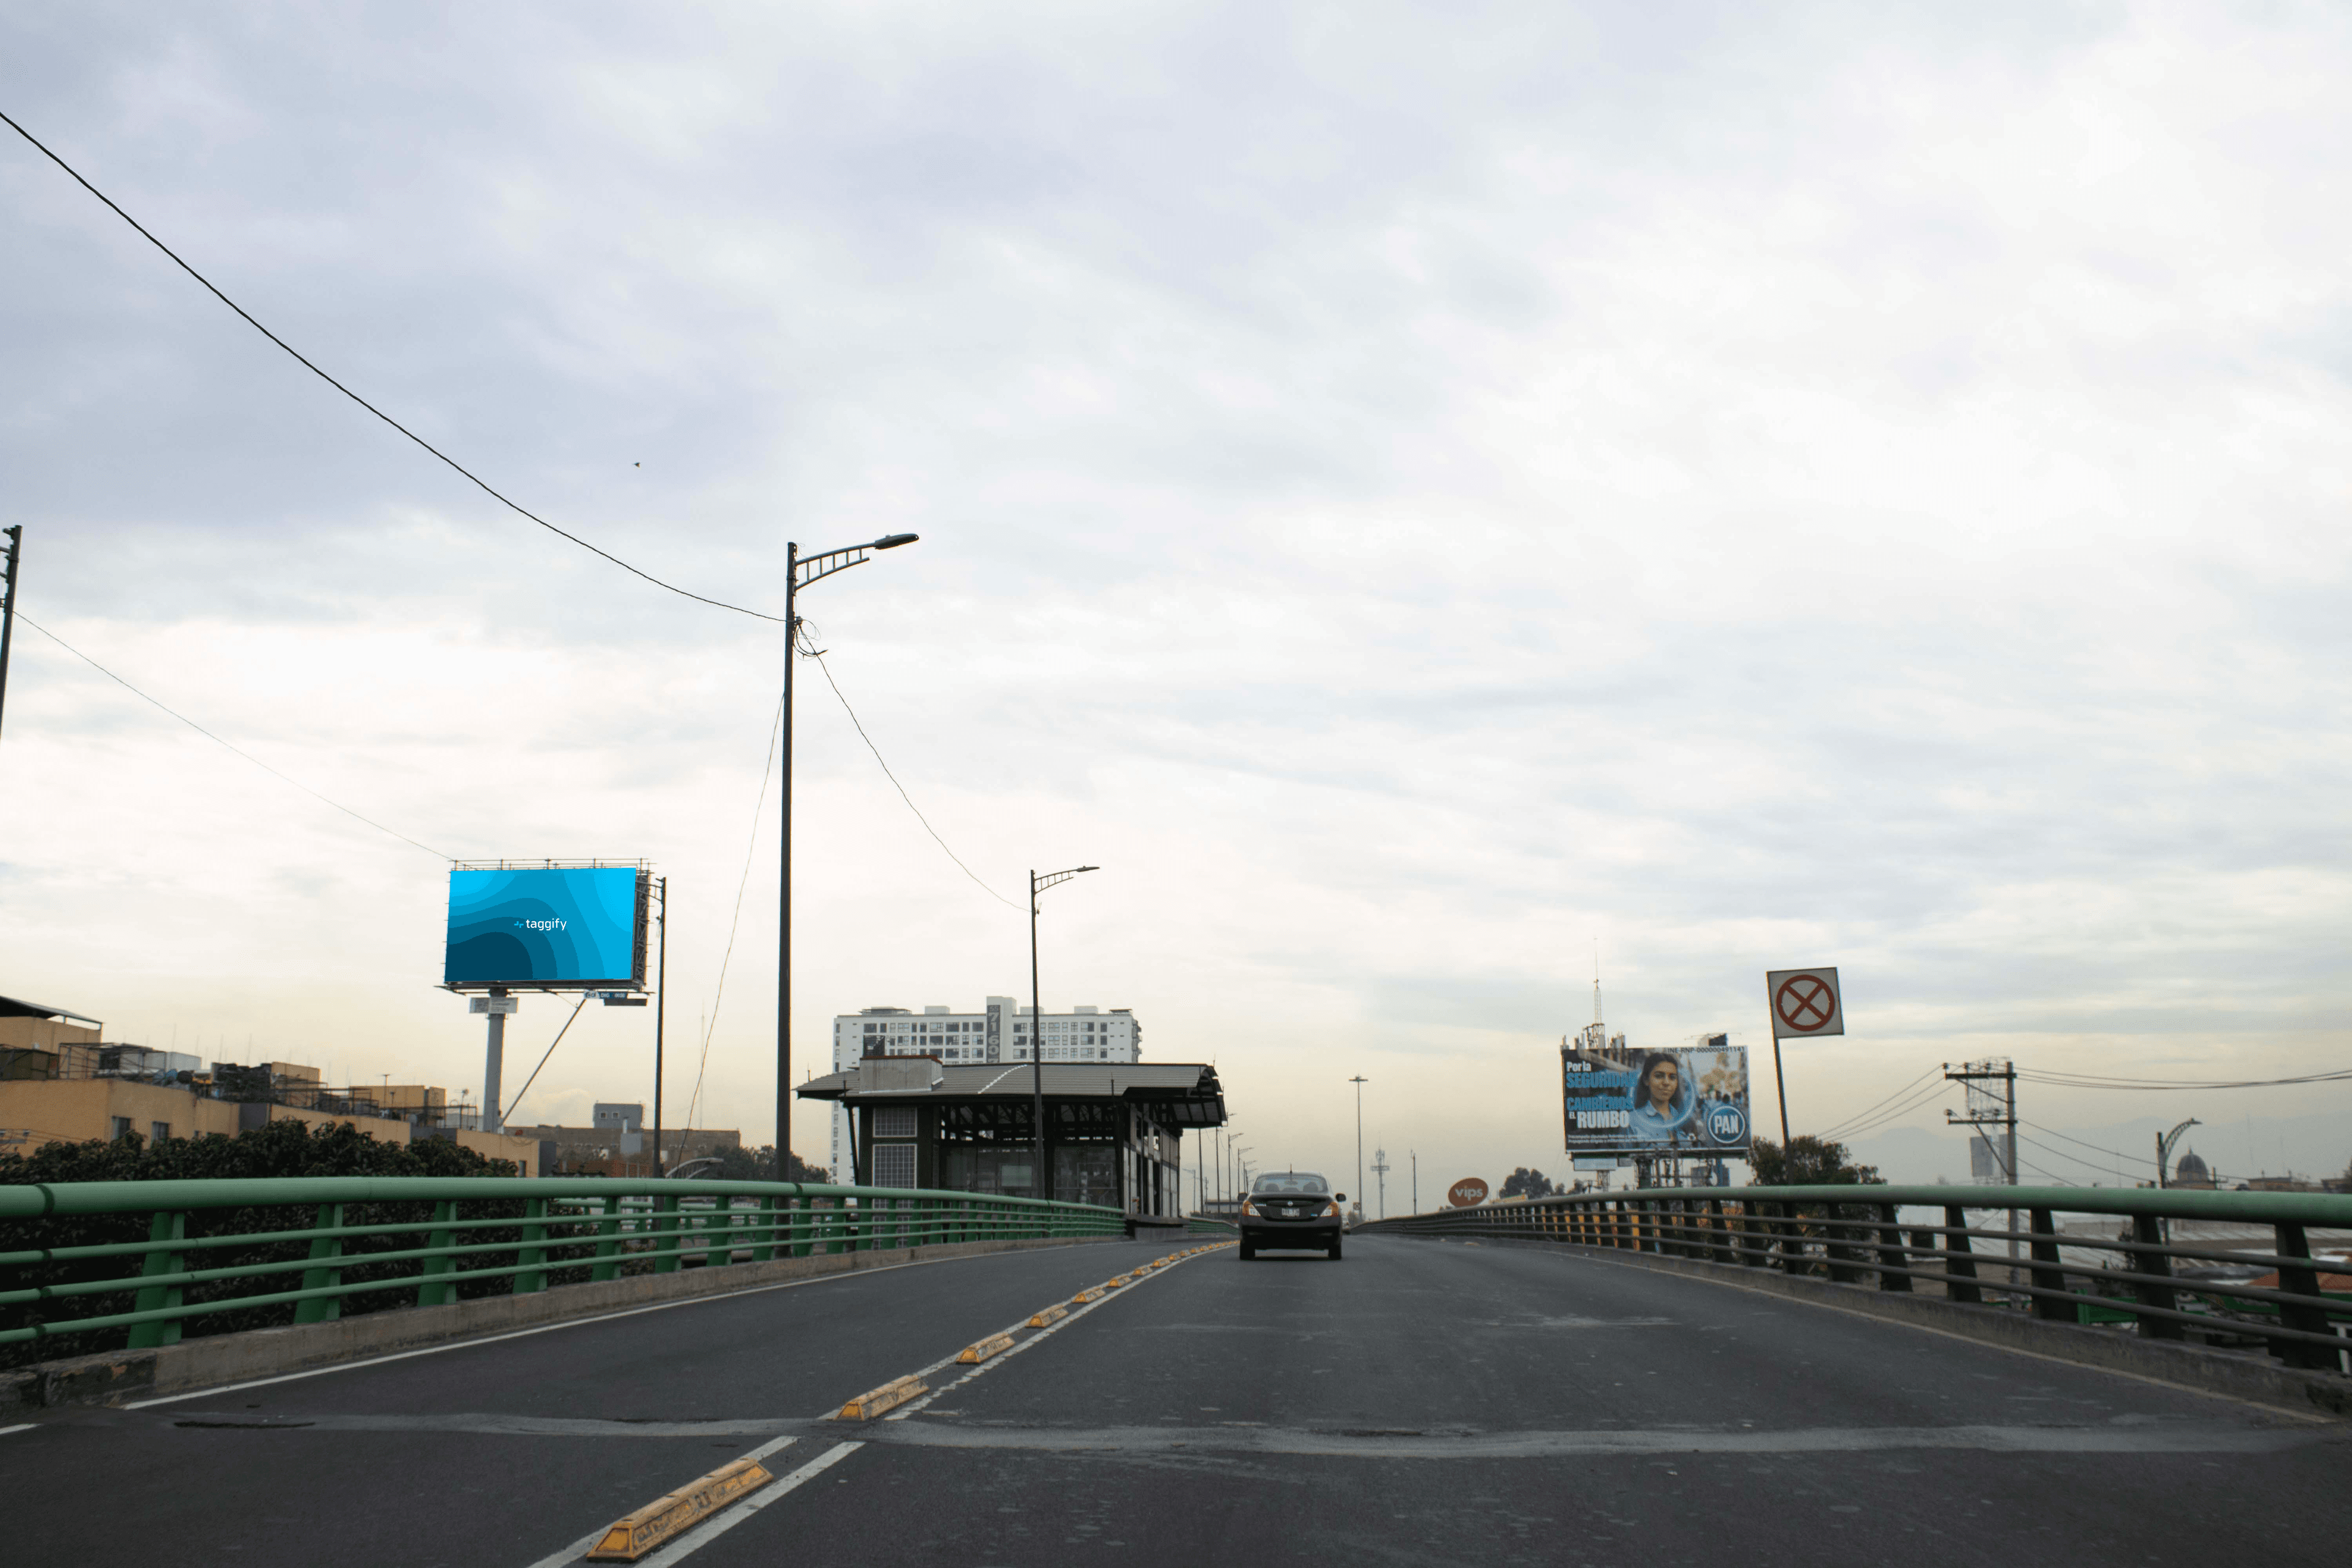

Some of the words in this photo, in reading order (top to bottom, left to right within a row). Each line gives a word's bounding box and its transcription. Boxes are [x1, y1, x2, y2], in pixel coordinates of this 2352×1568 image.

[526, 918, 567, 931] taggify
[1566, 1061, 1581, 1072] Por
[1582, 1060, 1592, 1072] la
[1569, 1111, 1576, 1120] EL
[1577, 1110, 1629, 1128] RUMBO
[1714, 1115, 1739, 1134] PAN
[1455, 1185, 1483, 1201] vips
